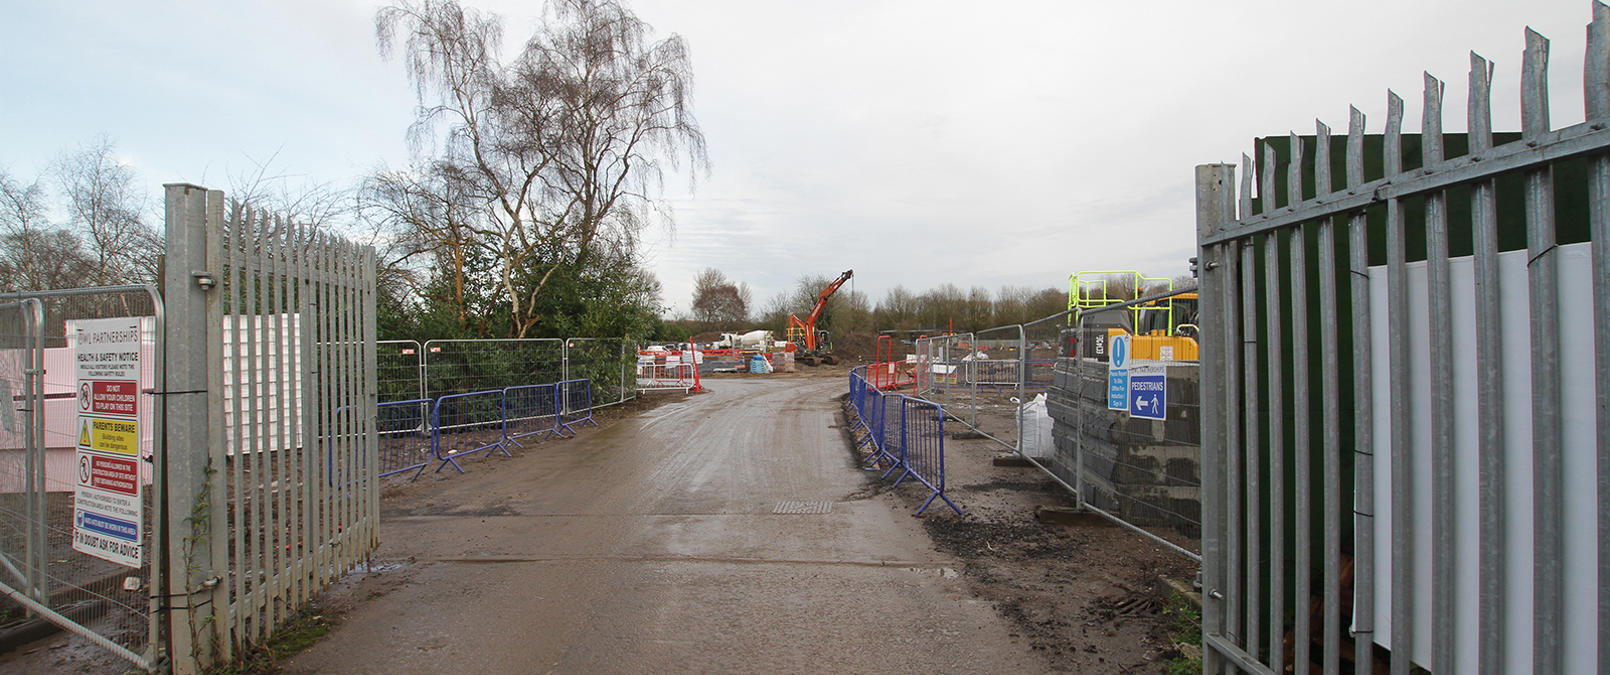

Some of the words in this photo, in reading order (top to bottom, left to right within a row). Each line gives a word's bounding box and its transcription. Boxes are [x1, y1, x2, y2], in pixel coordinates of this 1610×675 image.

[93, 330, 138, 344] PARTNERSHIPS
[78, 352, 94, 361] HEALTH
[96, 353, 99, 361] &
[100, 352, 117, 361] SAFETY
[119, 352, 138, 361] NOTICE
[1132, 381, 1163, 391] PEDESTRIANS
[92, 422, 113, 431] PARENTS
[115, 423, 135, 433] BEWARE
[80, 533, 84, 543] IN
[84, 534, 99, 548] DOUBT
[100, 538, 108, 550] ASK
[109, 540, 119, 553] FOR
[120, 543, 138, 559] ADVICE
